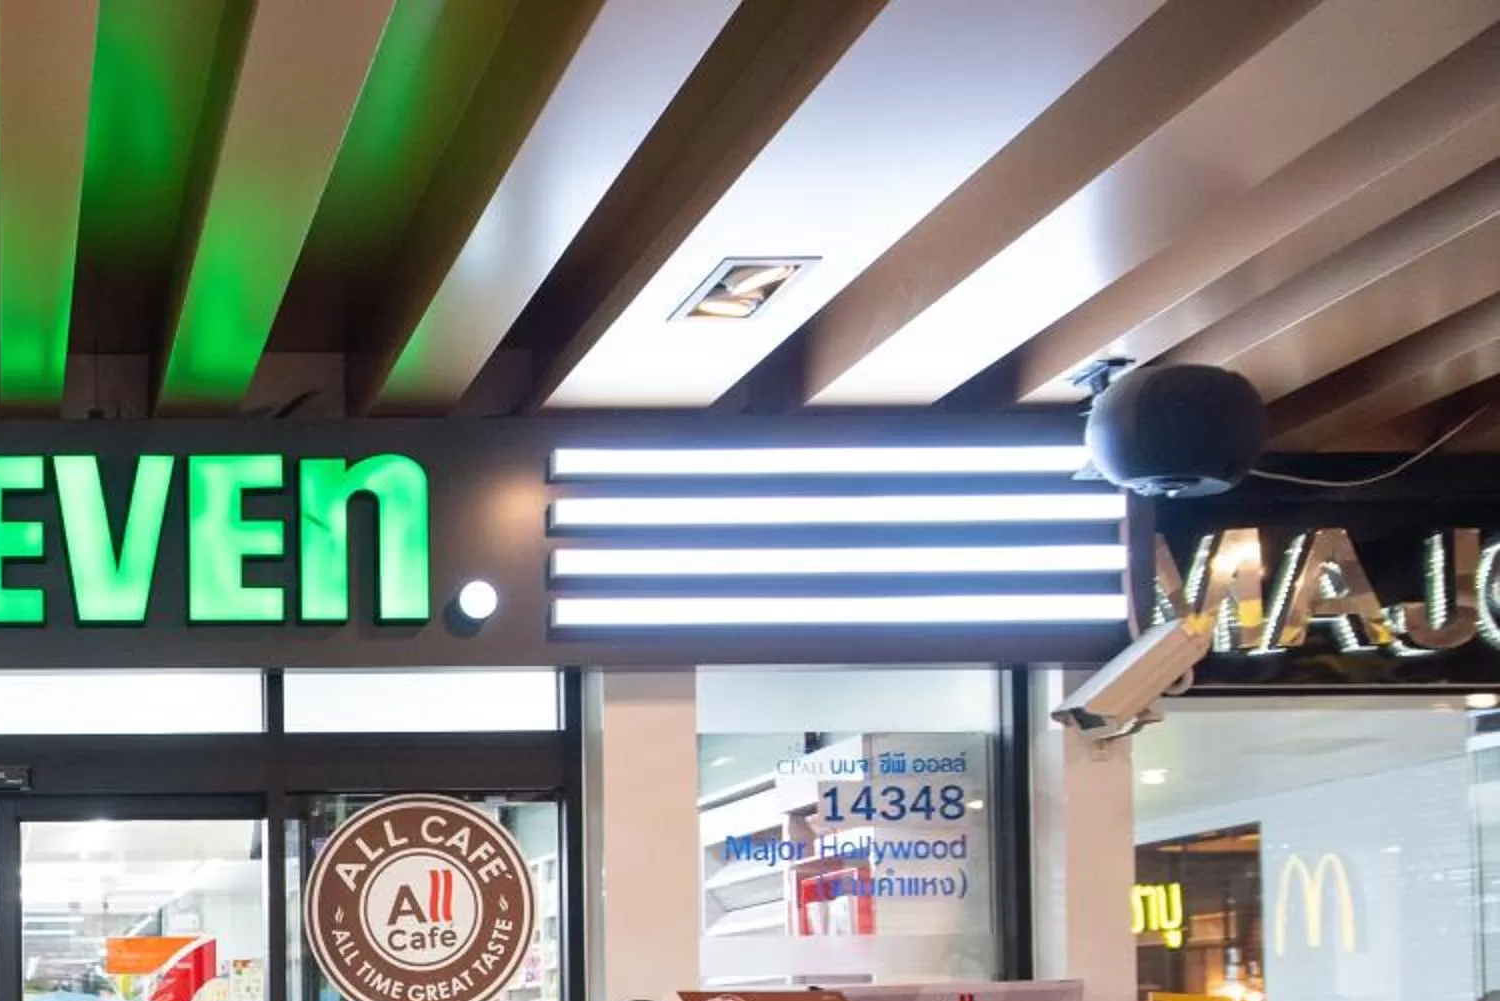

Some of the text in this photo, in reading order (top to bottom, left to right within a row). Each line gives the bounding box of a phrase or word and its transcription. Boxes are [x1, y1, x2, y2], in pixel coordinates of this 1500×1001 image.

[1154, 527, 1500, 652] MAJ
[823, 785, 967, 822] 14348
[335, 820, 408, 892] ALL
[723, 834, 967, 867] Major Hollywood
[332, 929, 360, 966] ALL
[355, 960, 404, 999] TIME
[471, 918, 514, 976] TASTE
